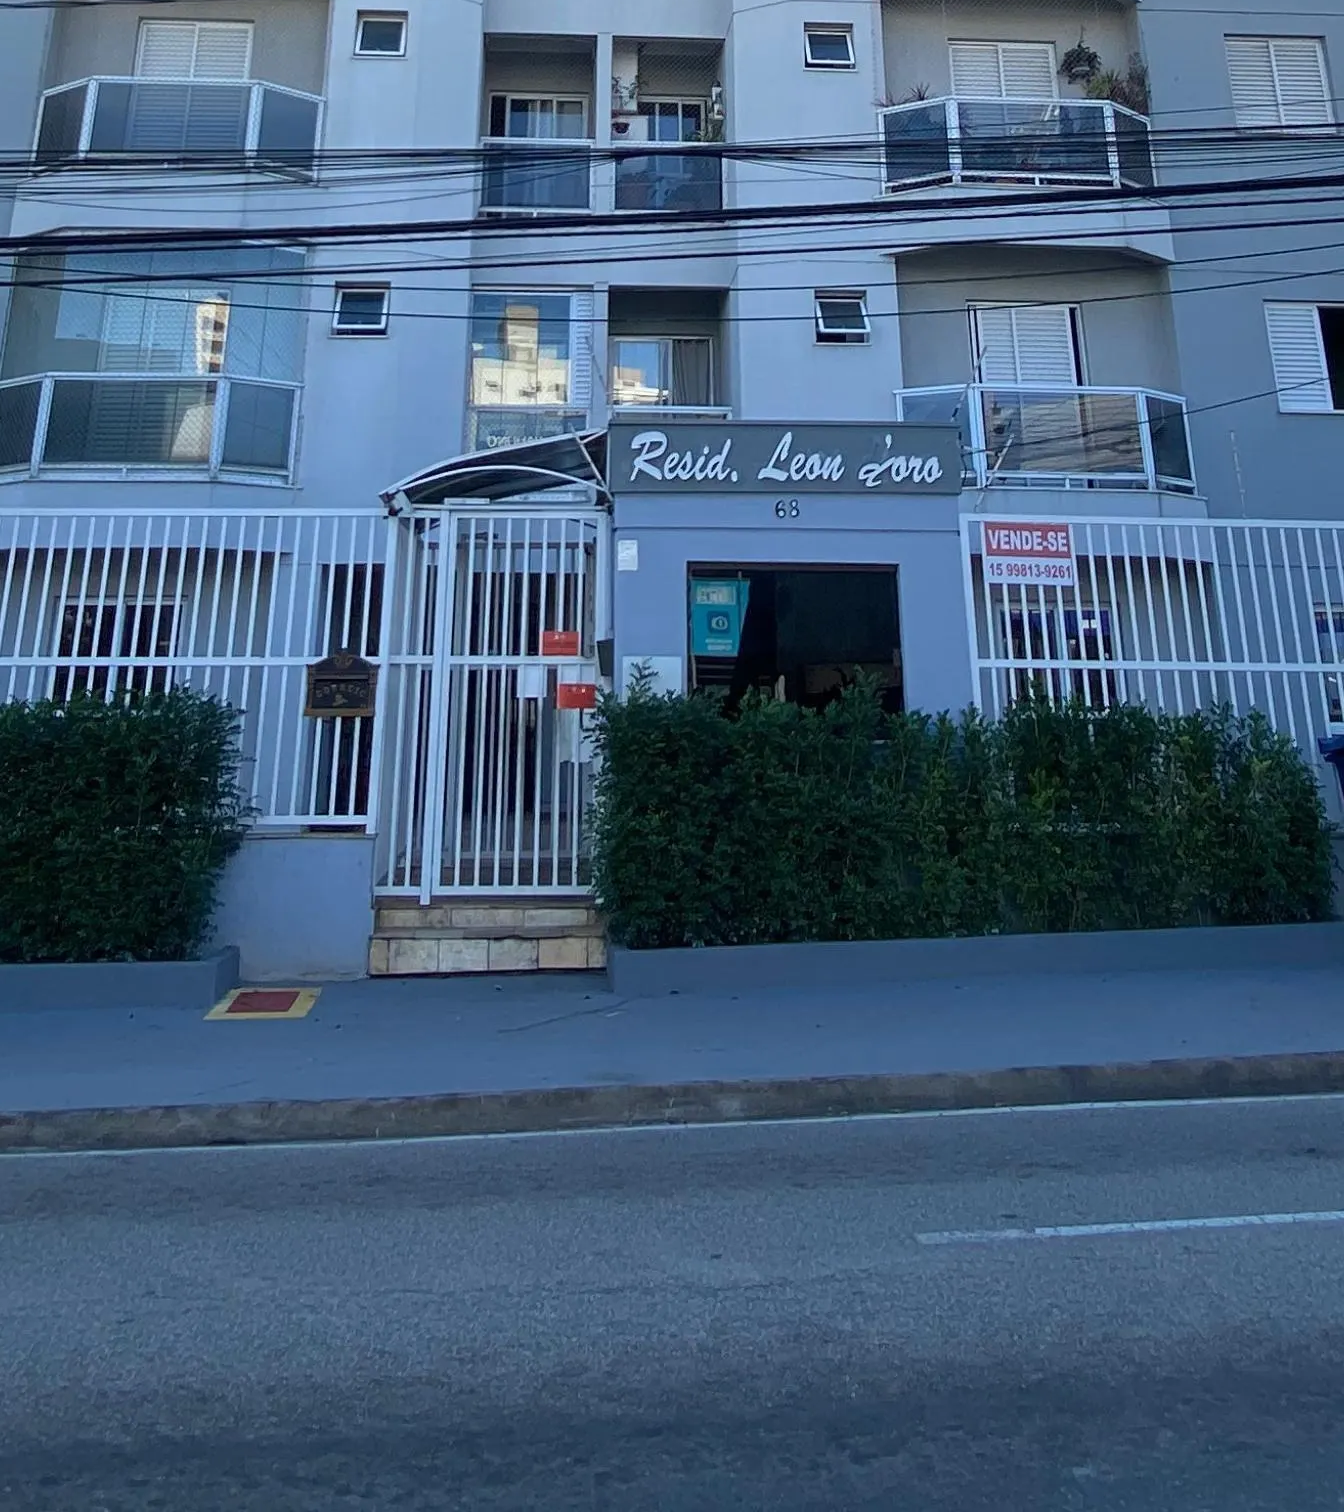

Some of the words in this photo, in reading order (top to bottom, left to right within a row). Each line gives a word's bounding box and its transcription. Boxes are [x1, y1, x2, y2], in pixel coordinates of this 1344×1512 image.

[630, 431, 739, 482] Resid.
[757, 431, 845, 482] Leon
[774, 499, 801, 519] 68
[987, 529, 1068, 553] VENDE-SE
[989, 563, 1003, 577] 15
